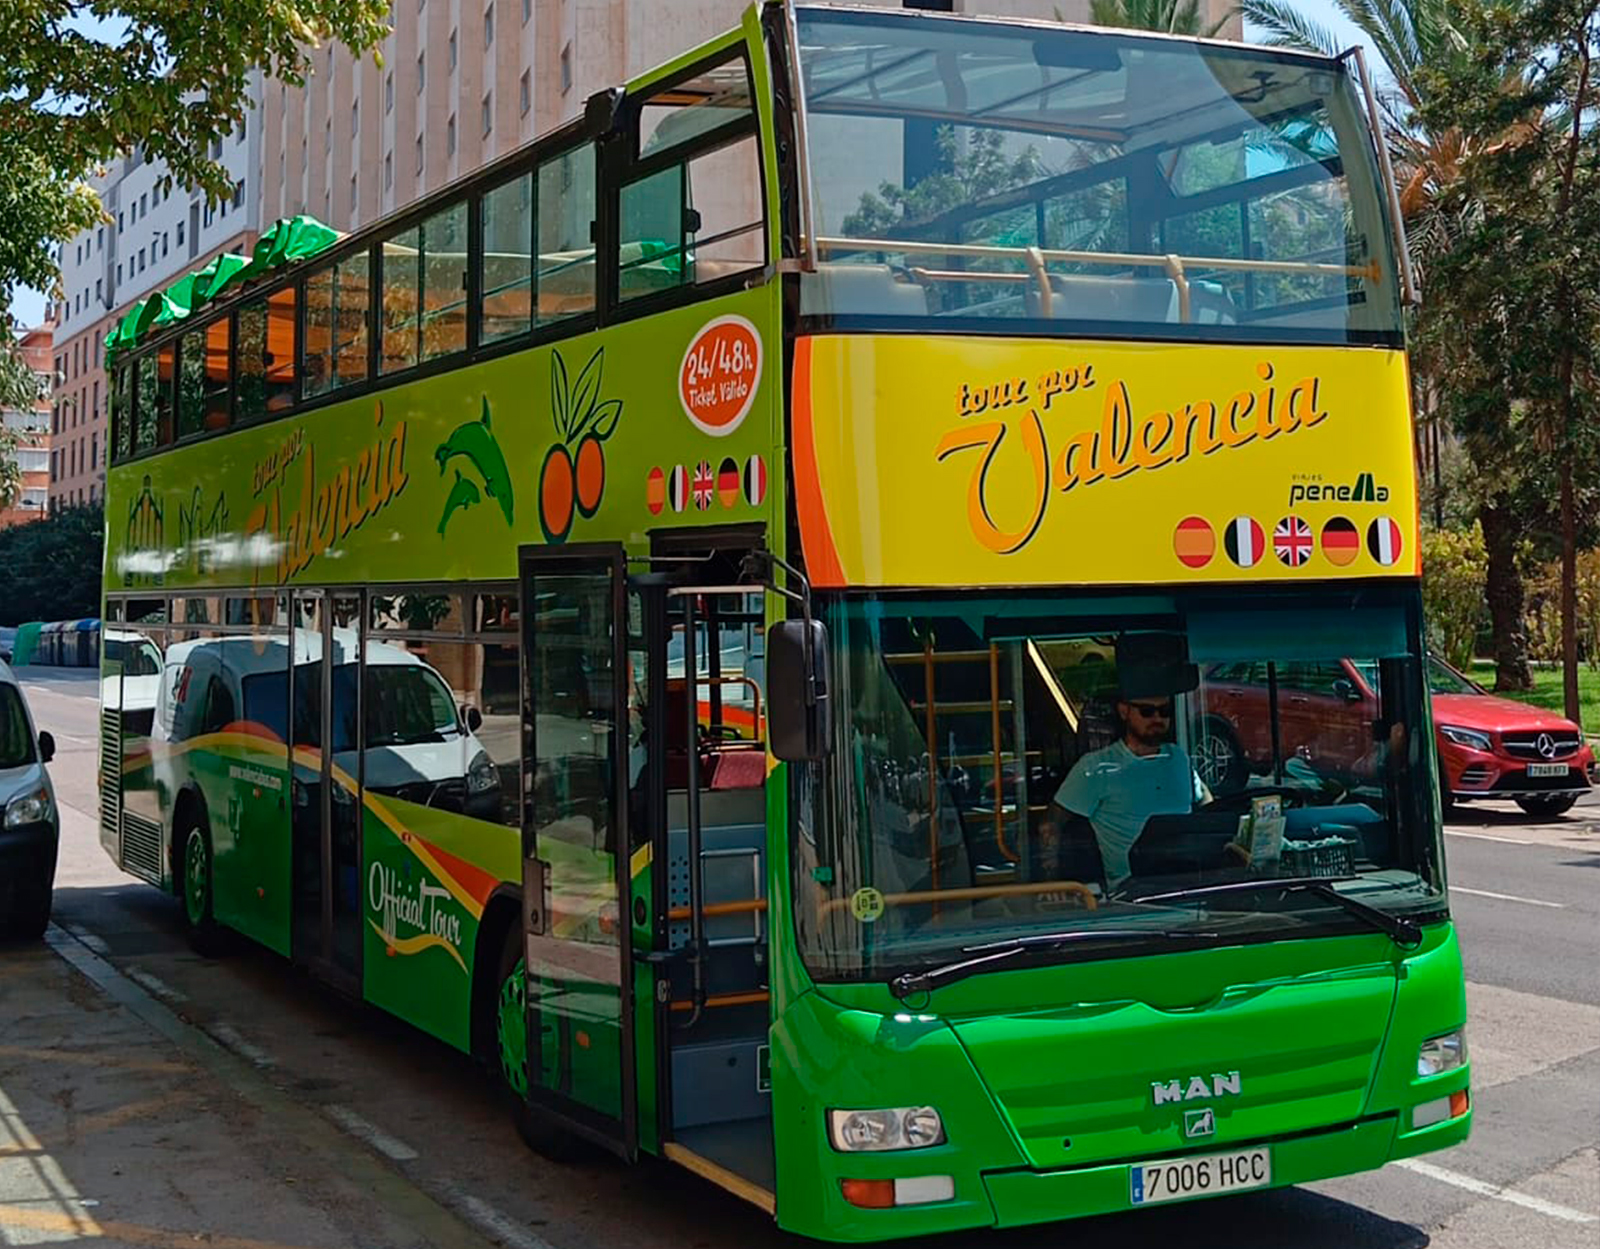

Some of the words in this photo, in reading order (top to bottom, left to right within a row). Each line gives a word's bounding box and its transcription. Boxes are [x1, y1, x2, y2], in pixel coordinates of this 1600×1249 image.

[688, 337, 753, 385] 24/48h
[955, 378, 1028, 416] tour
[1036, 364, 1096, 409] por
[935, 362, 1327, 554] Valencia
[1289, 473, 1389, 507] penella
[246, 399, 409, 655] Valencia
[369, 861, 426, 941] Official
[420, 878, 461, 945] Tour
[1151, 1071, 1241, 1105] MAN
[1148, 1161, 1210, 1197] 7006
[1219, 1153, 1264, 1186] HCC
